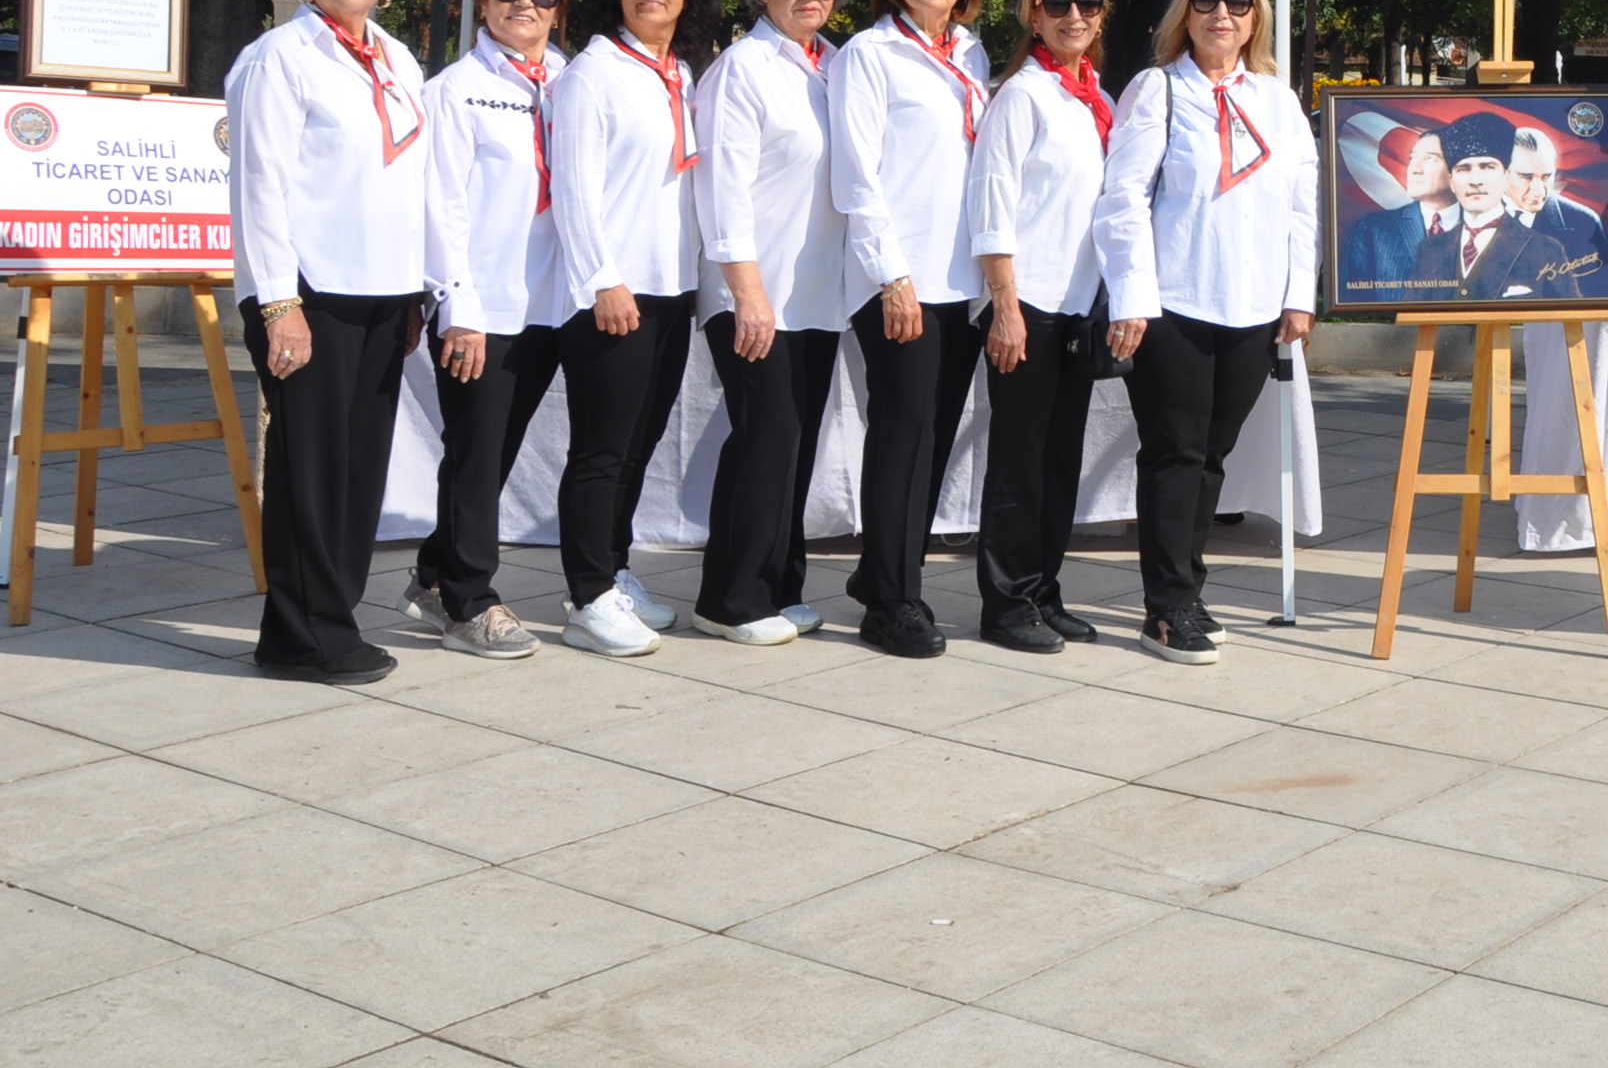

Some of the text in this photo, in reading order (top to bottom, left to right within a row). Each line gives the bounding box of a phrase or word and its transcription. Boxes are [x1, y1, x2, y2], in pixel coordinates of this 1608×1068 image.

[97, 138, 176, 159] SALİHLİ
[32, 158, 231, 184] TİCARET VE SANAY
[107, 188, 173, 206] ODASI
[0, 215, 233, 256] KADIN GİRİŞİMCİLER KU
[1346, 279, 1459, 290] SALİHLİ TİCARET VE SANAYİ ODASI
